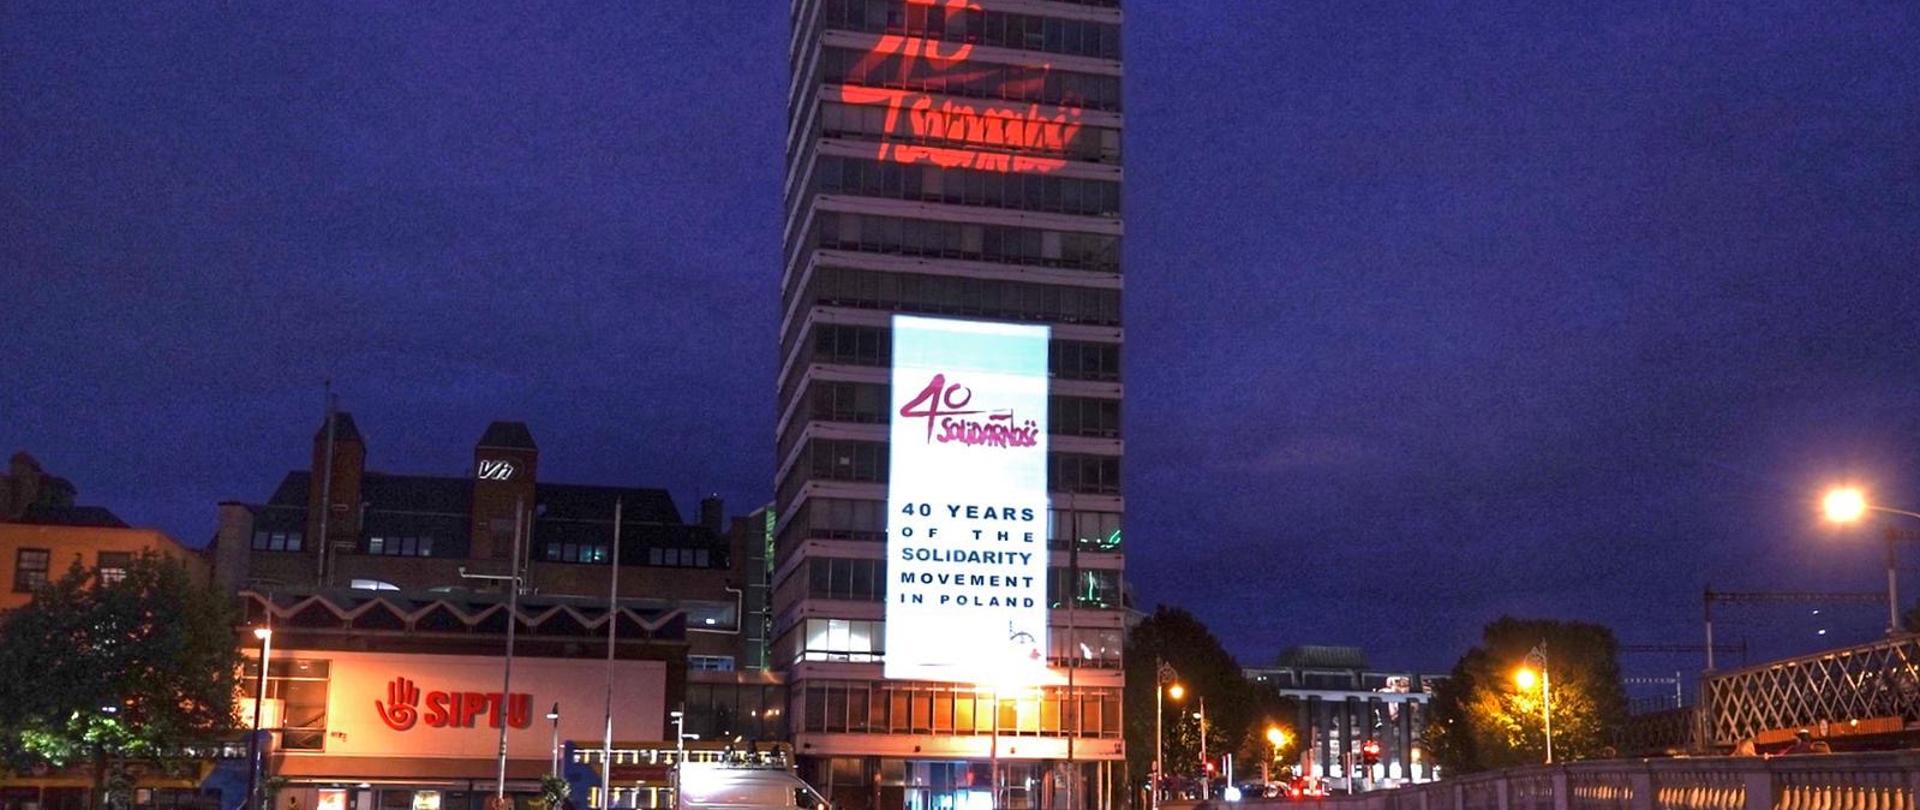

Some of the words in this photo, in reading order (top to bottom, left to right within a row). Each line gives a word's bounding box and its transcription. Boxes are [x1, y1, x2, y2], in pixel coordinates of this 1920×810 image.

[900, 373, 972, 444] 40
[901, 502, 932, 517] 40
[946, 504, 1034, 522] YEARS
[901, 526, 938, 538] OF
[971, 529, 1034, 543] THE
[901, 547, 1032, 566] SOLIDARITY
[900, 571, 1034, 589] MOVEMENT
[900, 593, 923, 604] IN
[940, 594, 1035, 608] POLAND
[424, 691, 533, 729] SIPTU
